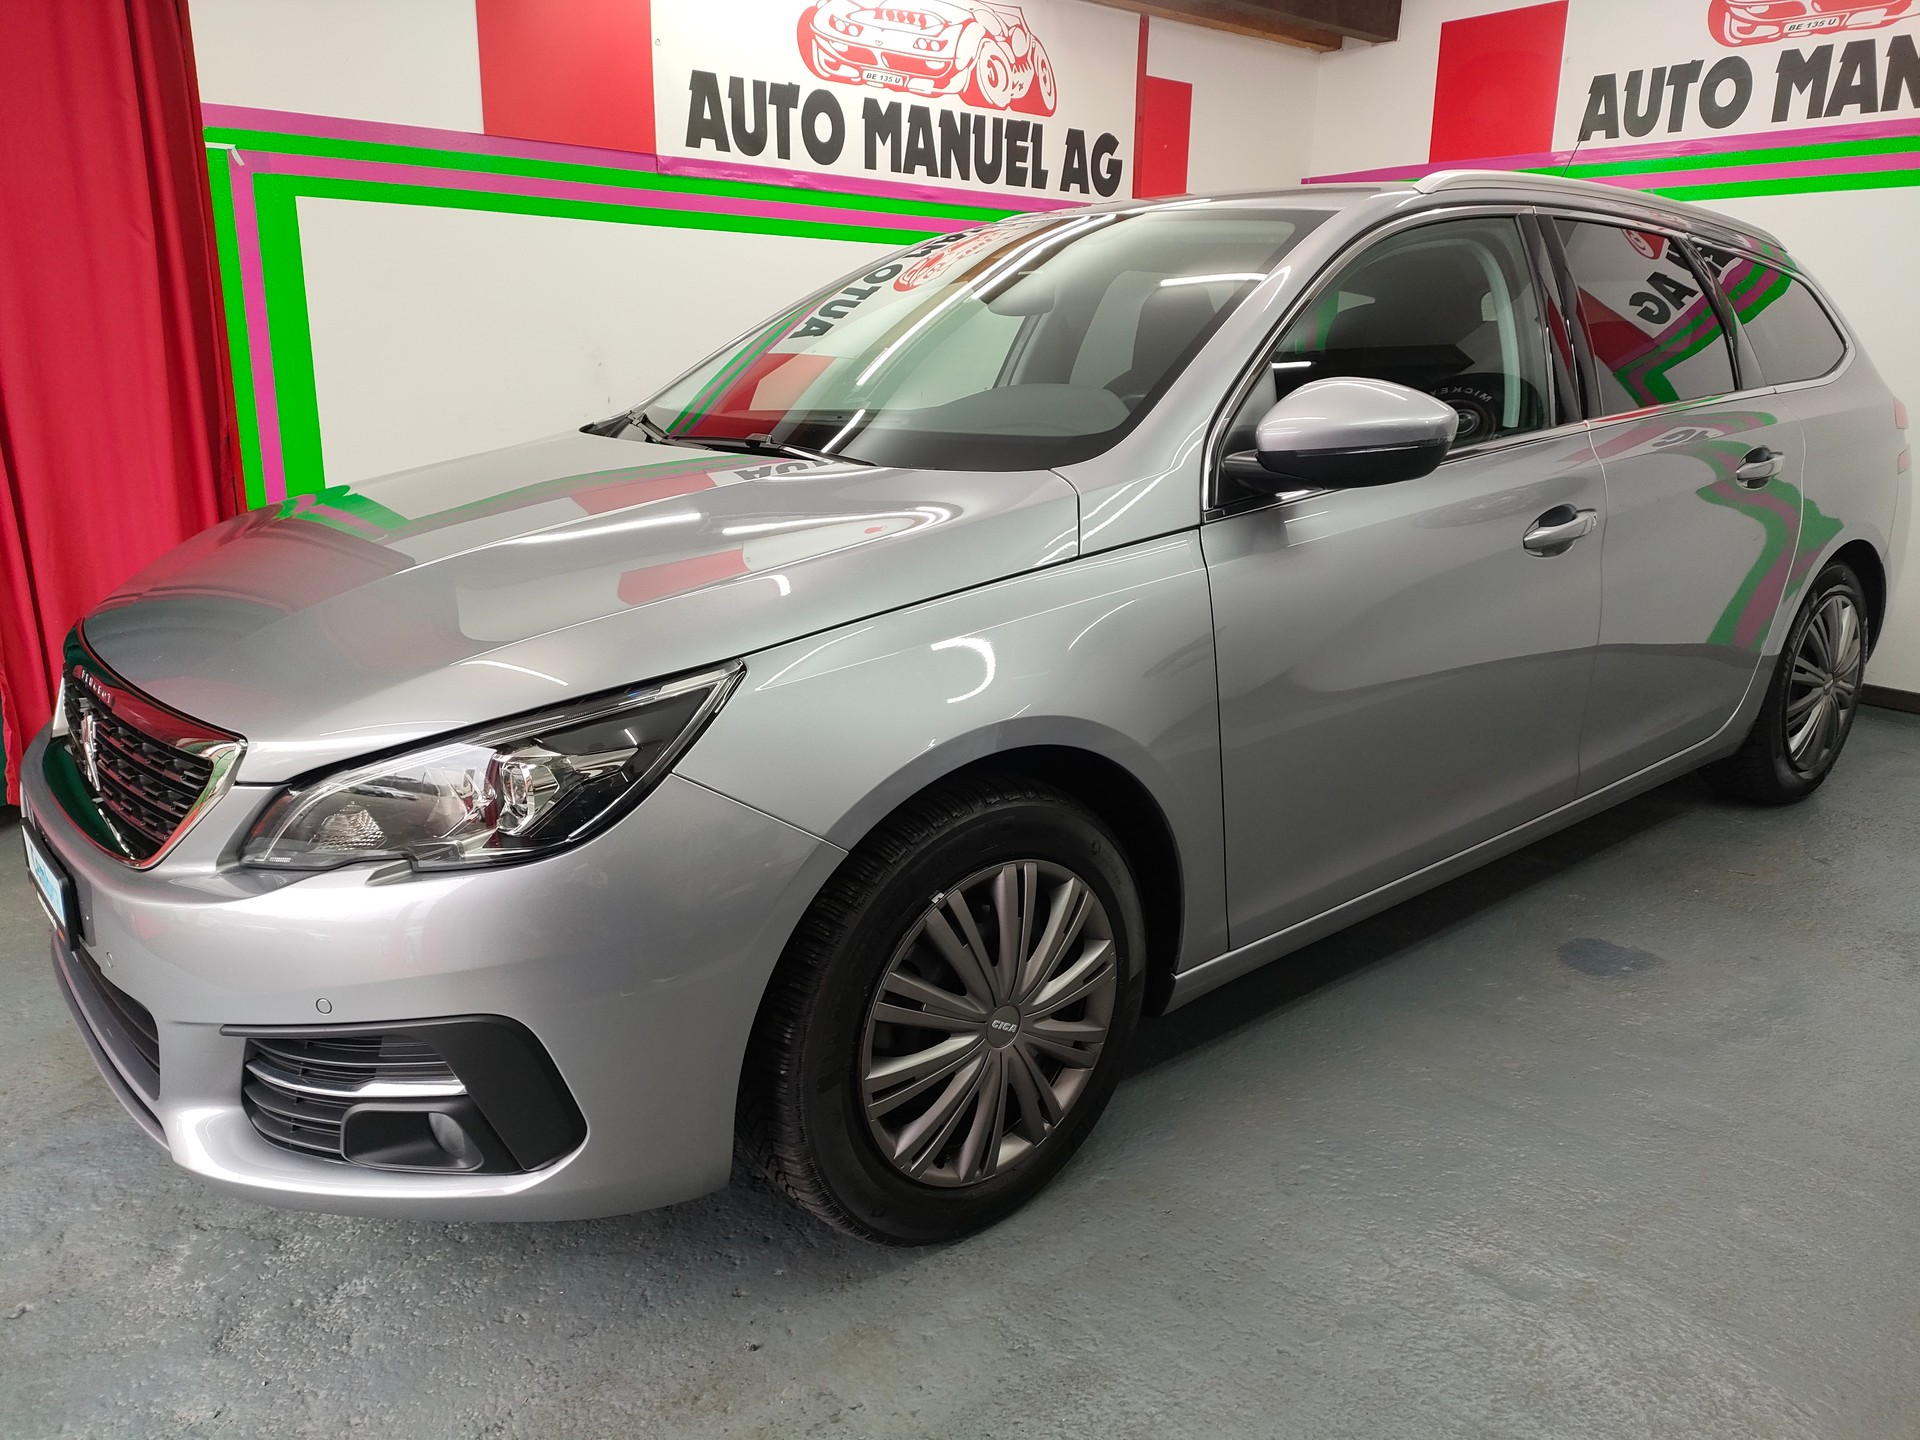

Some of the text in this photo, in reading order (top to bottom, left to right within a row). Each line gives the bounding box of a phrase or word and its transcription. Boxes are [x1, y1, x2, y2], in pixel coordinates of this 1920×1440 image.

[1788, 23, 1803, 31] BE
[1806, 20, 1826, 29] 135
[865, 72, 878, 80] BE
[879, 74, 893, 82] 135
[1577, 55, 1753, 142] AUTO
[685, 69, 1123, 198] AUTO MANUEL AG
